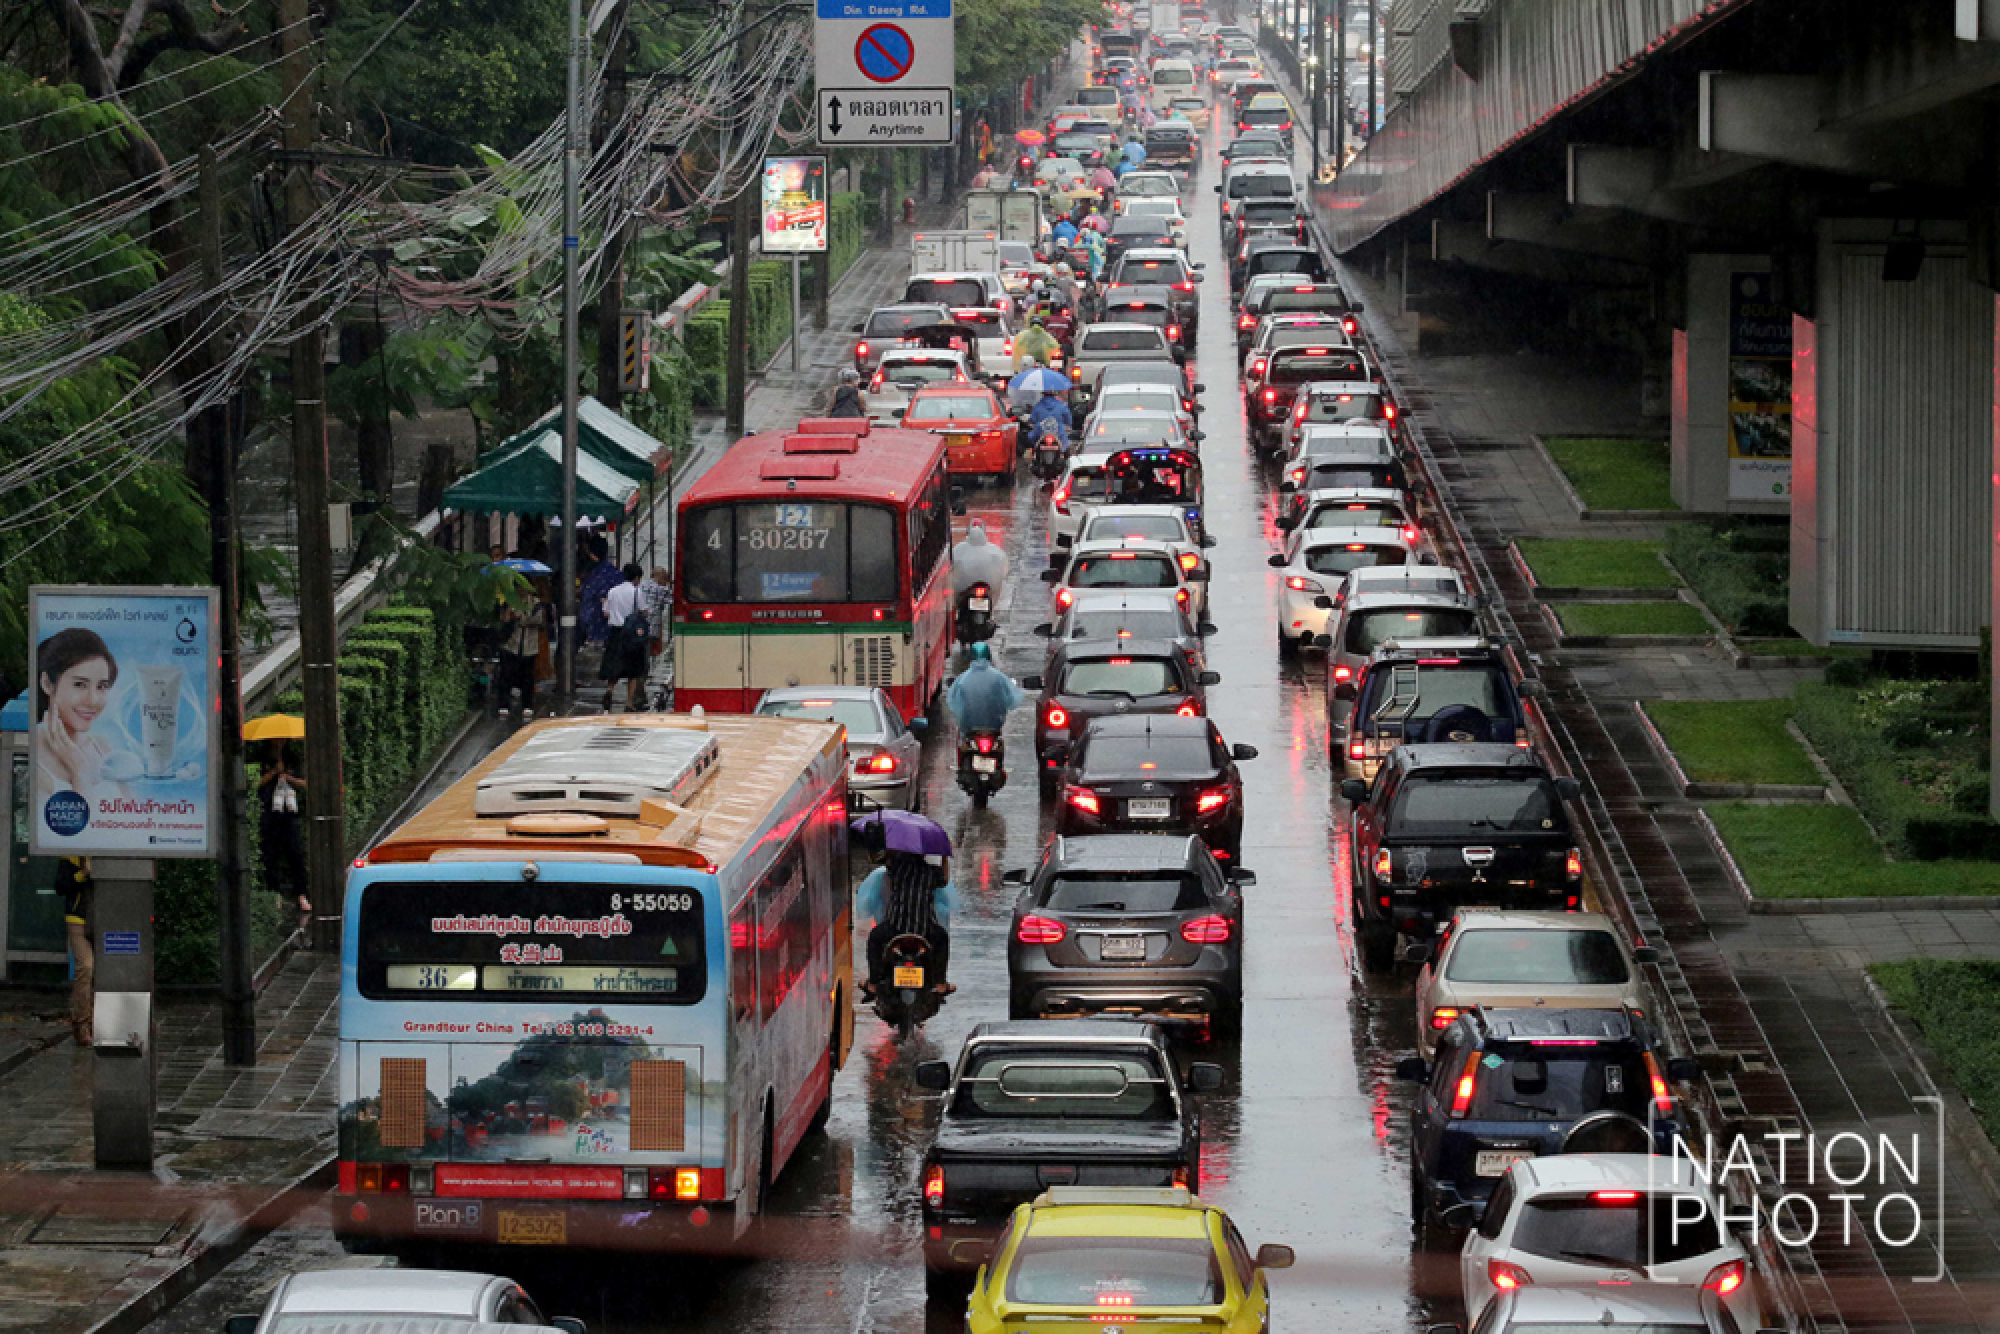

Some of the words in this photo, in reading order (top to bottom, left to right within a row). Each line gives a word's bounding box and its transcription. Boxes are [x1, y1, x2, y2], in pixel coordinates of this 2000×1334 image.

[844, 6, 862, 15] Din
[869, 6, 903, 17] Daeng
[910, 6, 928, 15] Rd.
[849, 100, 944, 117] ตลอดเวลา
[868, 124, 925, 138] Anytime
[707, 528, 722, 549] 4
[47, 801, 86, 811] JAPAN
[49, 811, 83, 821] MADE
[610, 893, 693, 911] 8-55059
[418, 966, 447, 989] 36
[403, 1020, 471, 1034] Grandtour
[475, 1021, 514, 1034] China
[502, 1216, 563, 1235] 12-5375
